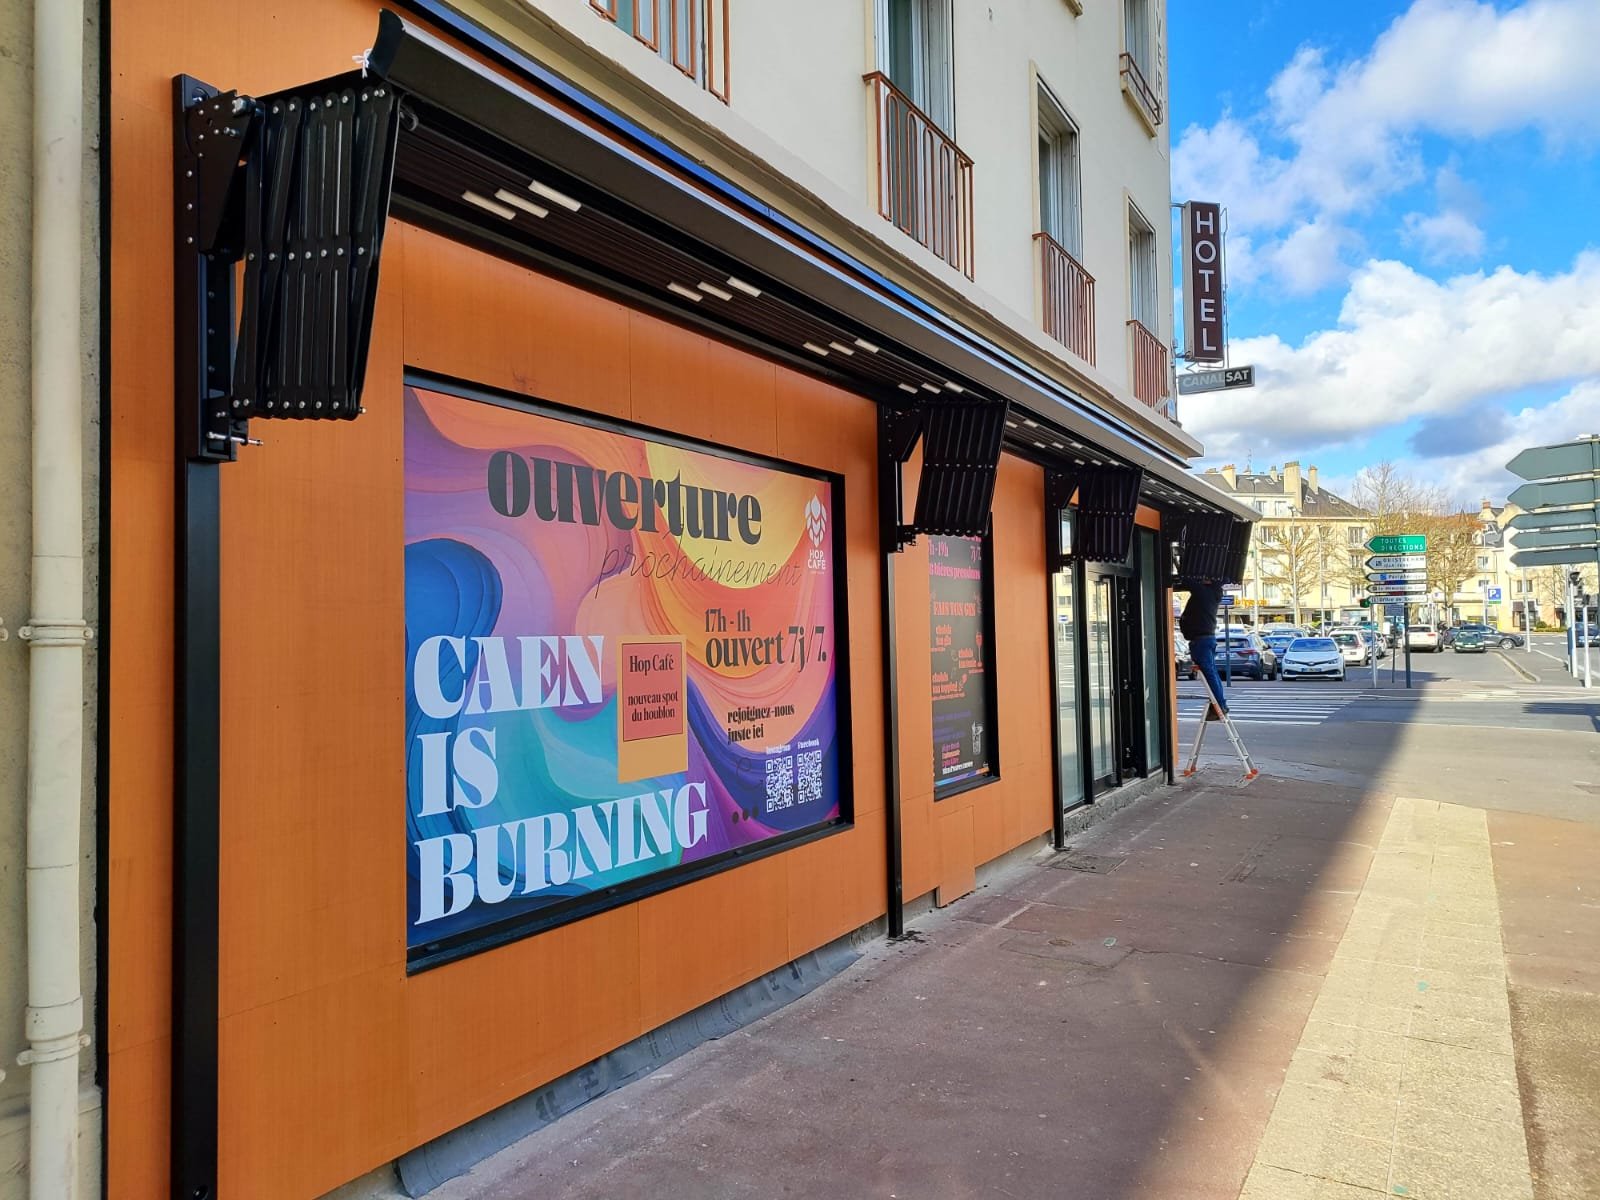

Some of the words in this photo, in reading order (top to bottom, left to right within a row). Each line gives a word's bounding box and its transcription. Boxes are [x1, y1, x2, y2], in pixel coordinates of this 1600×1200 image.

[1195, 210, 1217, 351] HOTEL
[487, 450, 762, 545] ouverture
[594, 508, 802, 600] prochainement
[809, 550, 824, 559] HOP
[704, 608, 727, 633] 17h
[629, 655, 650, 675] Hop
[652, 654, 674, 671] Café
[705, 631, 785, 668] ouvert
[788, 626, 827, 673] 7j/7.
[413, 634, 605, 720] CAEN
[628, 693, 661, 706] nouveau
[662, 690, 678, 704] spot
[631, 711, 642, 722] du
[643, 706, 675, 721] houblon
[727, 703, 795, 725] rejoignez-nous
[727, 726, 751, 745] juste
[752, 723, 764, 738] ici
[417, 726, 499, 818] IS
[413, 780, 710, 926] BURNING
